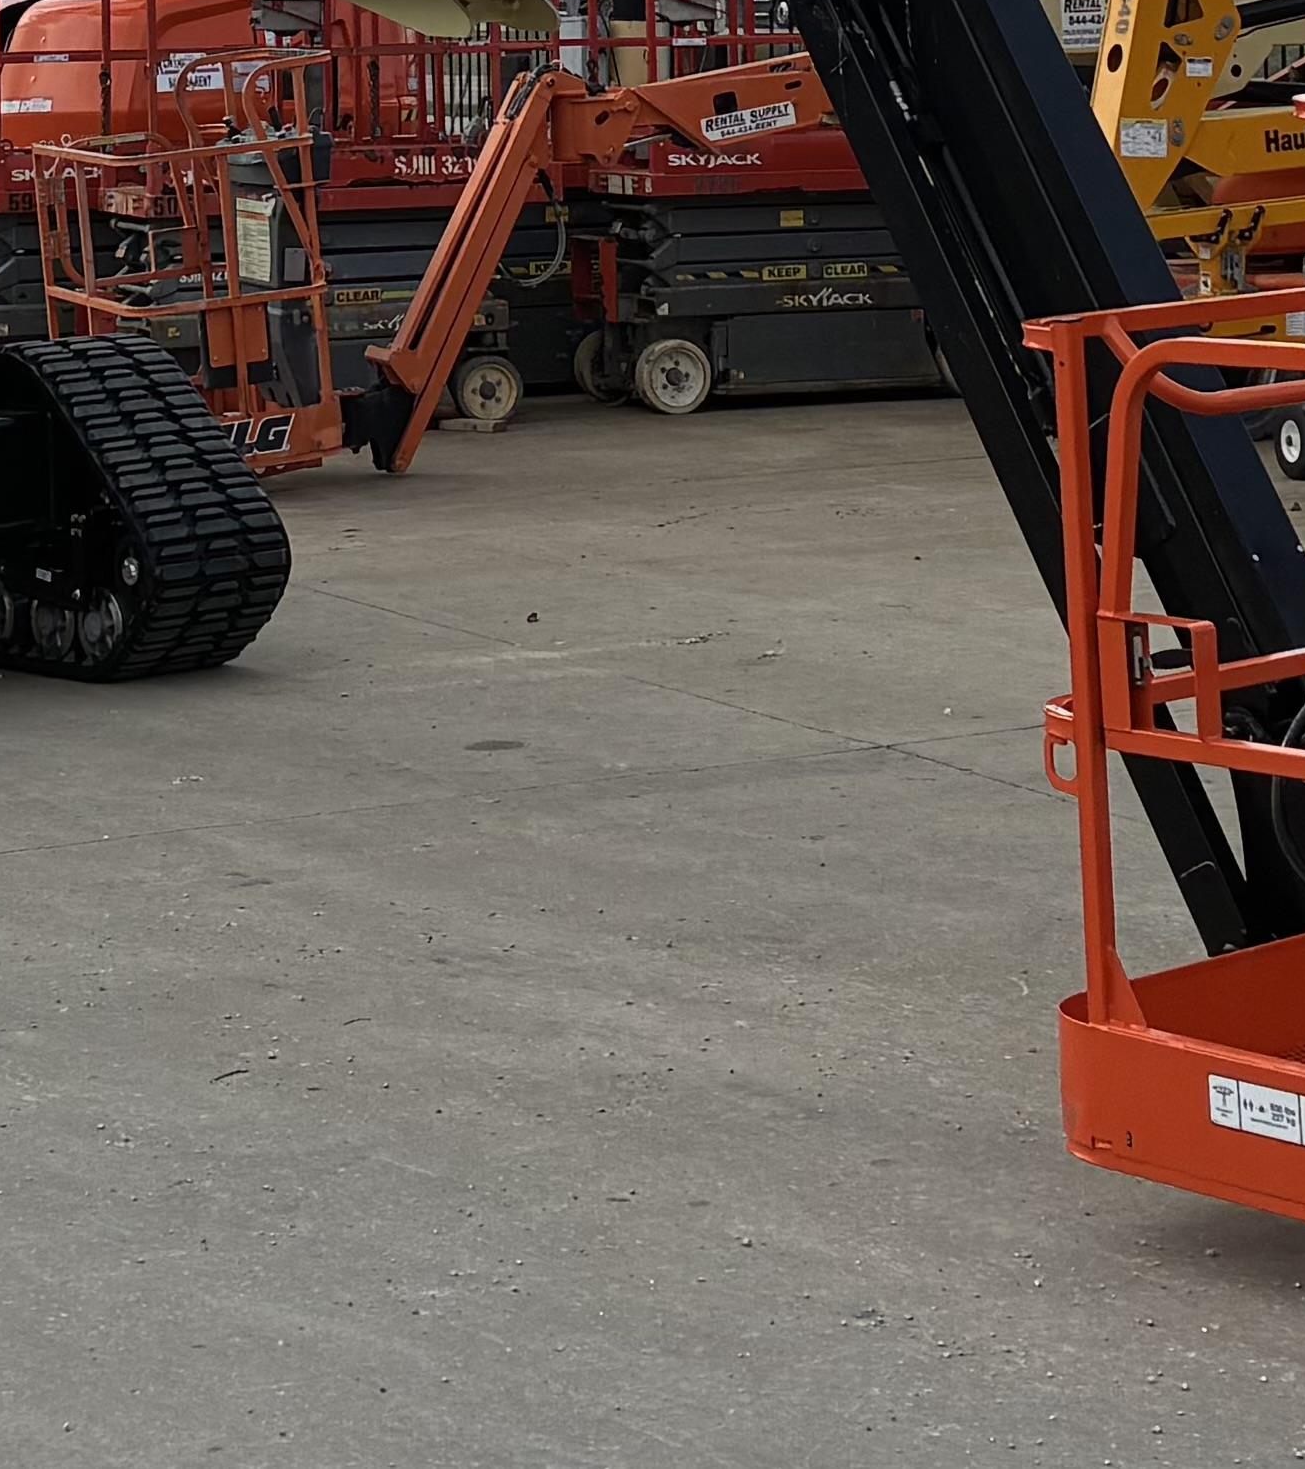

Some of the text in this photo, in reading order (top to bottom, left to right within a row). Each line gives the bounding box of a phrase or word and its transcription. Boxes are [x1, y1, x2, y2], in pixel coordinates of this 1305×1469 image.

[705, 103, 790, 133] RENTAL SUPPLY
[667, 152, 764, 169] SKYJACK
[767, 263, 866, 278] KEEP CLEAR
[336, 290, 380, 303] CLEAR
[781, 287, 873, 307] SKYJACK
